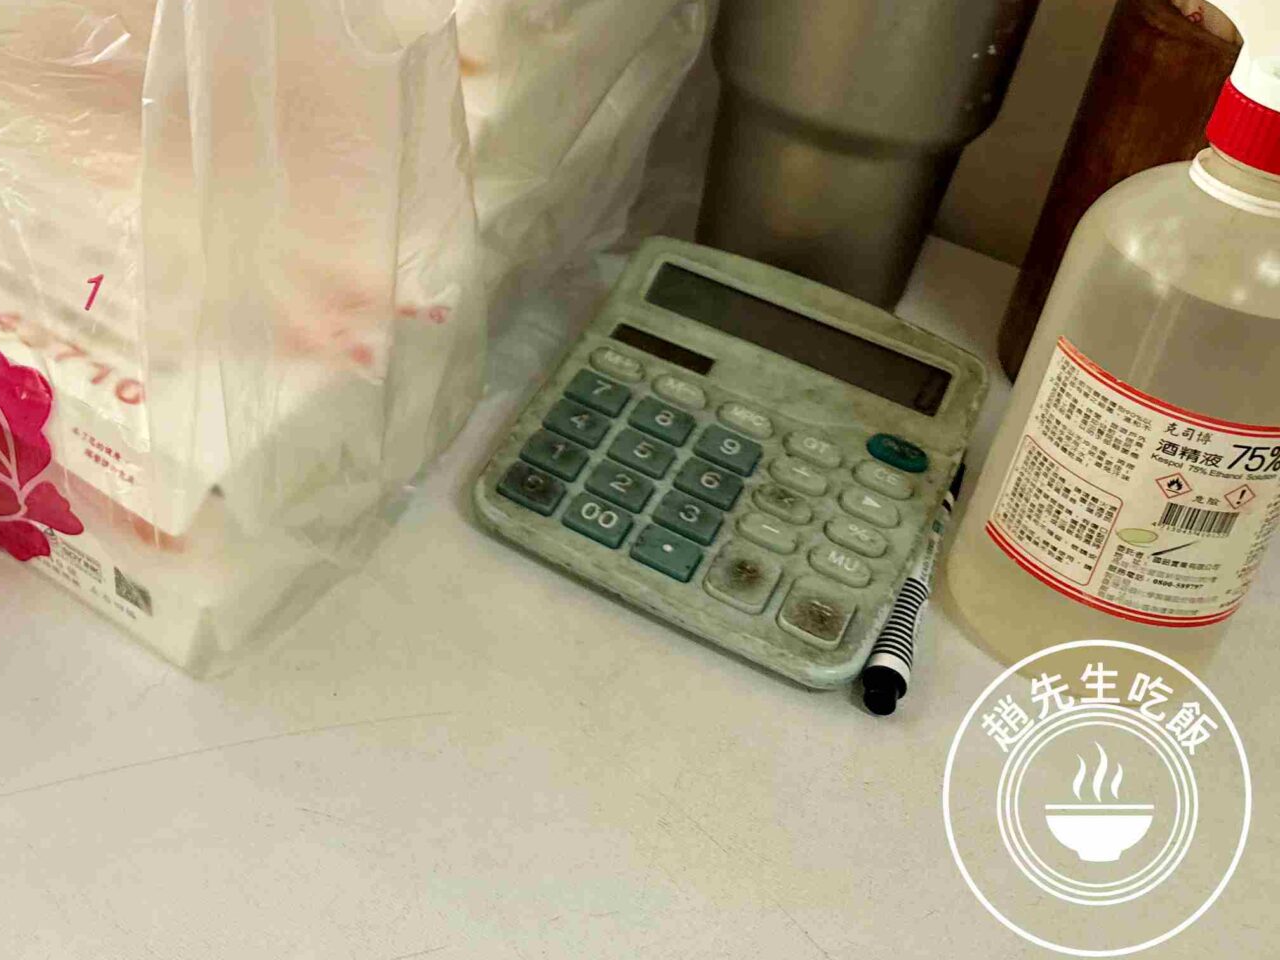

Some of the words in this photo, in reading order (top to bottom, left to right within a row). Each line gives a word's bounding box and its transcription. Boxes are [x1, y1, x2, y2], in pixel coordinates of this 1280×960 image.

[592, 379, 613, 395] 7
[570, 413, 590, 430] 4
[654, 410, 675, 427] 8
[632, 440, 656, 459] 5
[719, 438, 742, 456] 9
[1155, 438, 1225, 469] 酒精液
[609, 473, 633, 494] 2
[699, 471, 721, 489] 6
[581, 502, 619, 529] 00
[679, 503, 701, 523] 3
